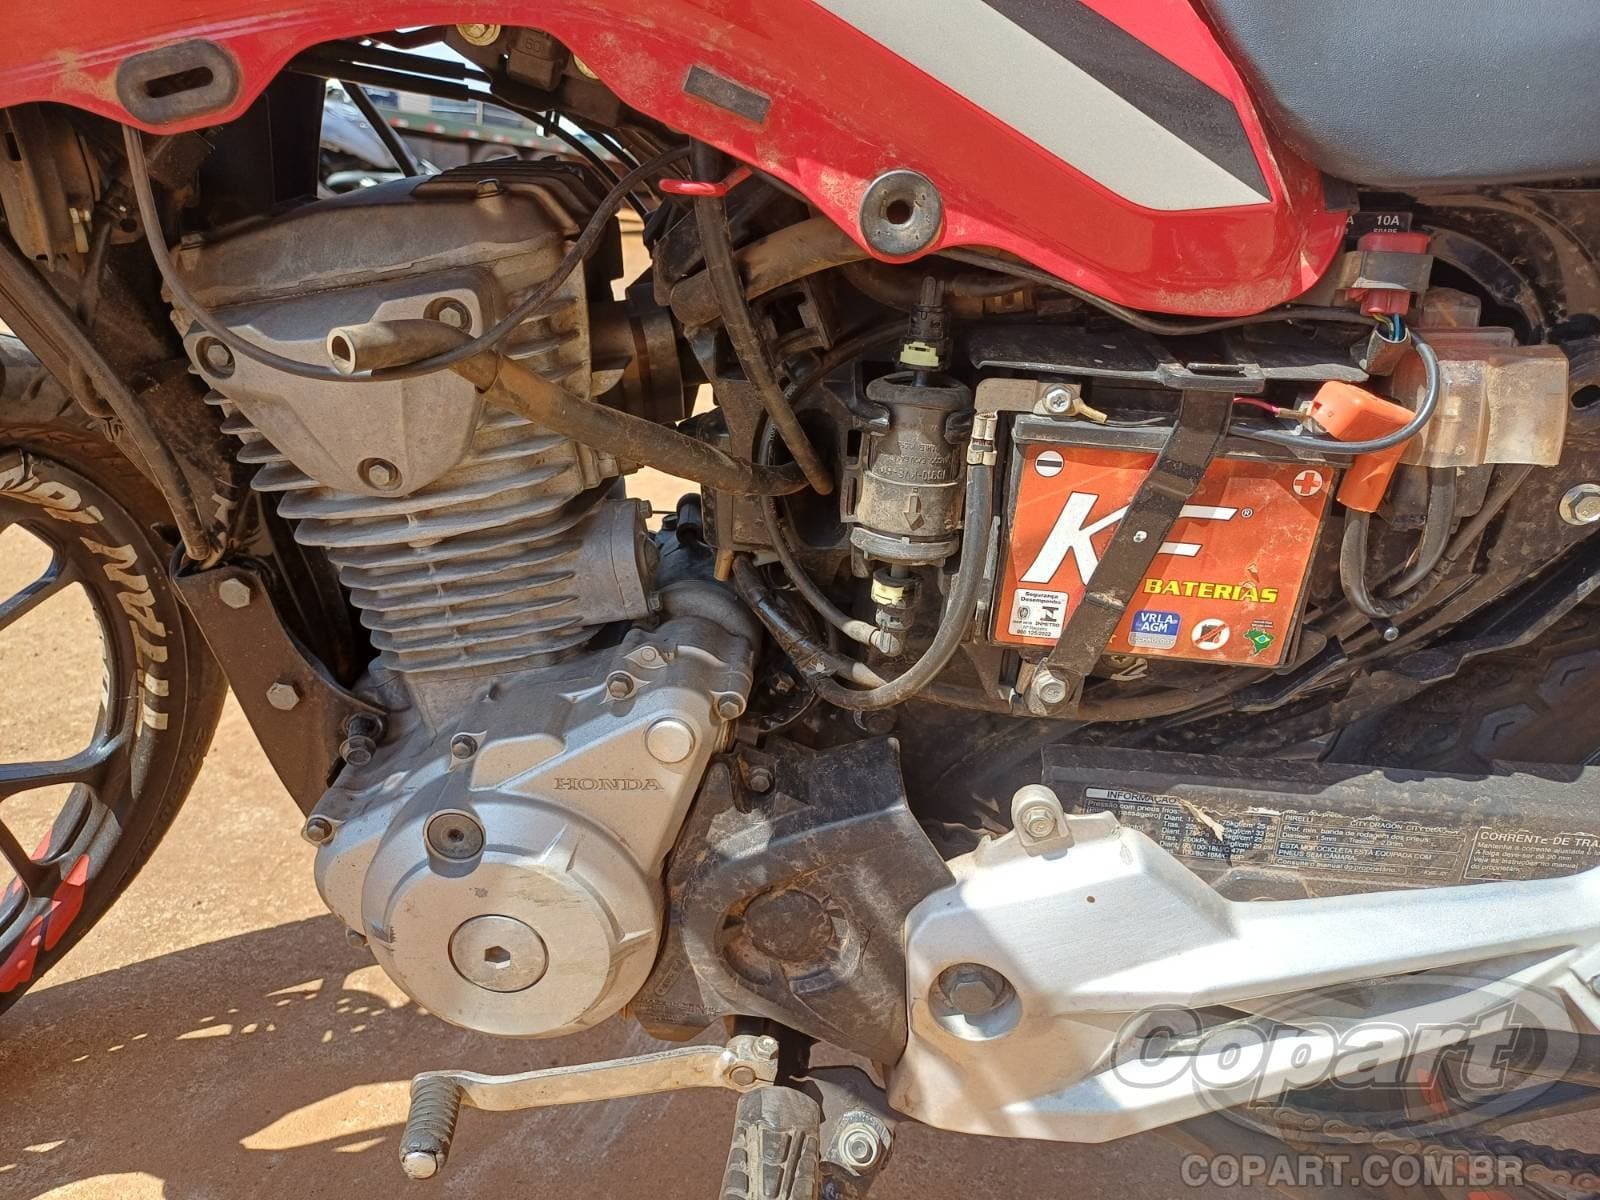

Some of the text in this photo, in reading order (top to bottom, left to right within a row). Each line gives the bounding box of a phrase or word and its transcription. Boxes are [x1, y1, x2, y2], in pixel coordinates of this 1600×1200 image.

[1376, 215, 1400, 226] 10A
[1144, 578, 1279, 603] BATERIAS
[1140, 612, 1173, 623] VRLA
[1141, 621, 1168, 632] AGM
[80, 537, 169, 737] TITAN
[553, 777, 665, 791] HONDA
[1369, 822, 1402, 830] DRAGON
[1552, 836, 1570, 846] DE
[1575, 838, 1600, 848] TRA
[1278, 849, 1304, 857] PNEUS
[1375, 850, 1413, 858] EQUIPADA
